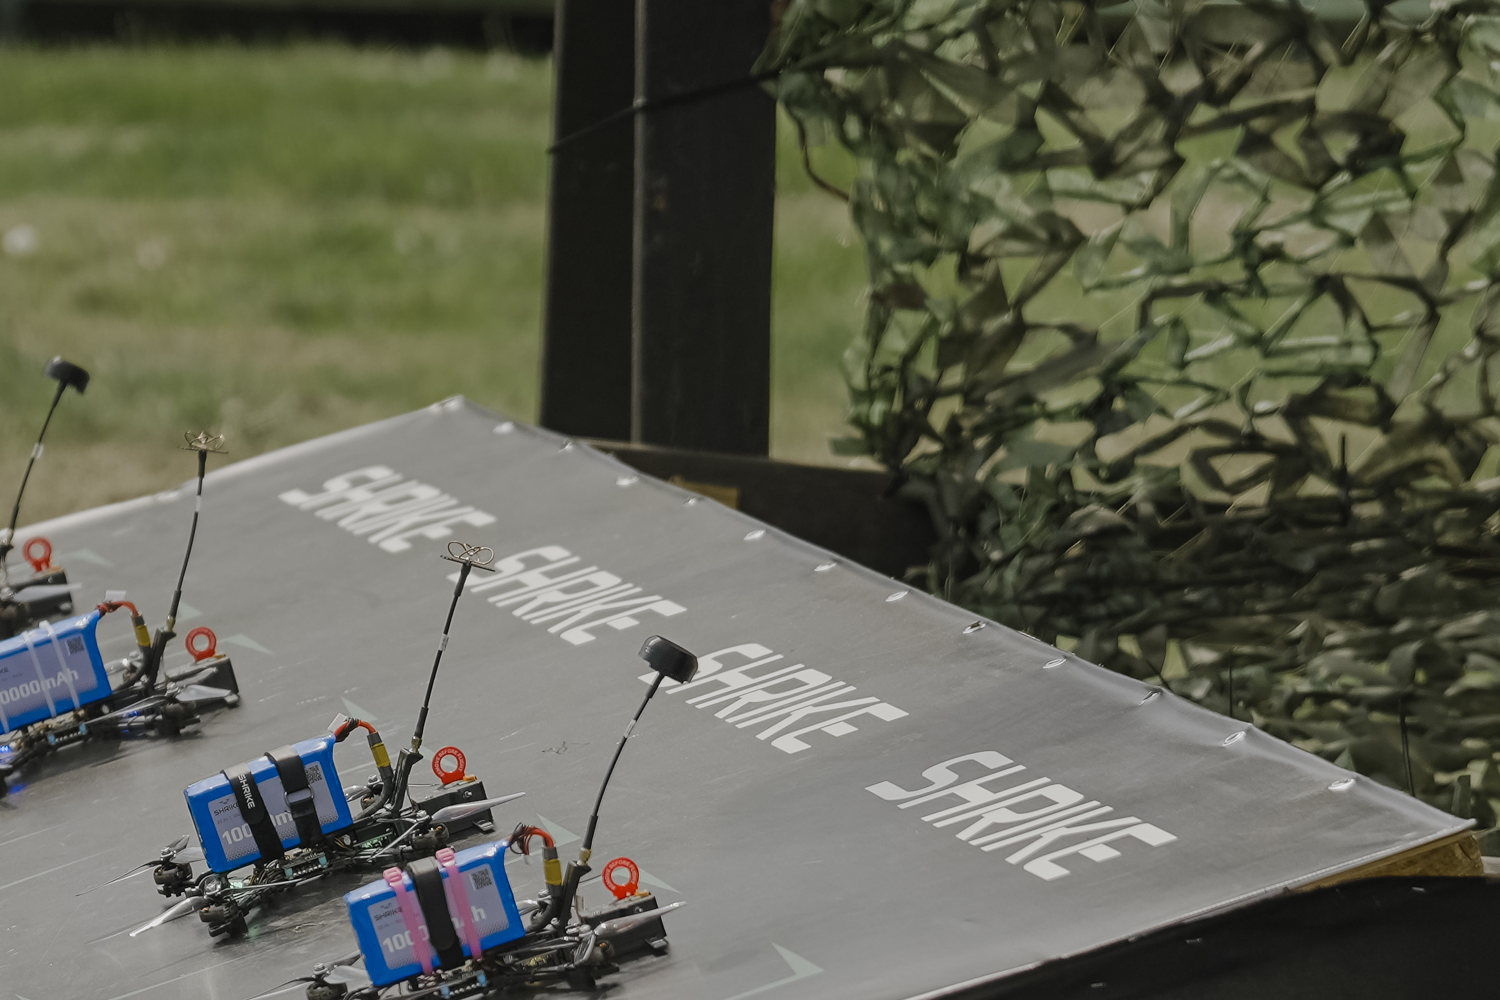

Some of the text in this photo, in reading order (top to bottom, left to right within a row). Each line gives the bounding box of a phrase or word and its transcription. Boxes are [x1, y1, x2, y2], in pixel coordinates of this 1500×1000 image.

[277, 464, 498, 553] SHRIKE
[446, 545, 688, 646] SHRIKE
[237, 773, 256, 810] SHRIKE
[864, 750, 1179, 881] SHRIKE
